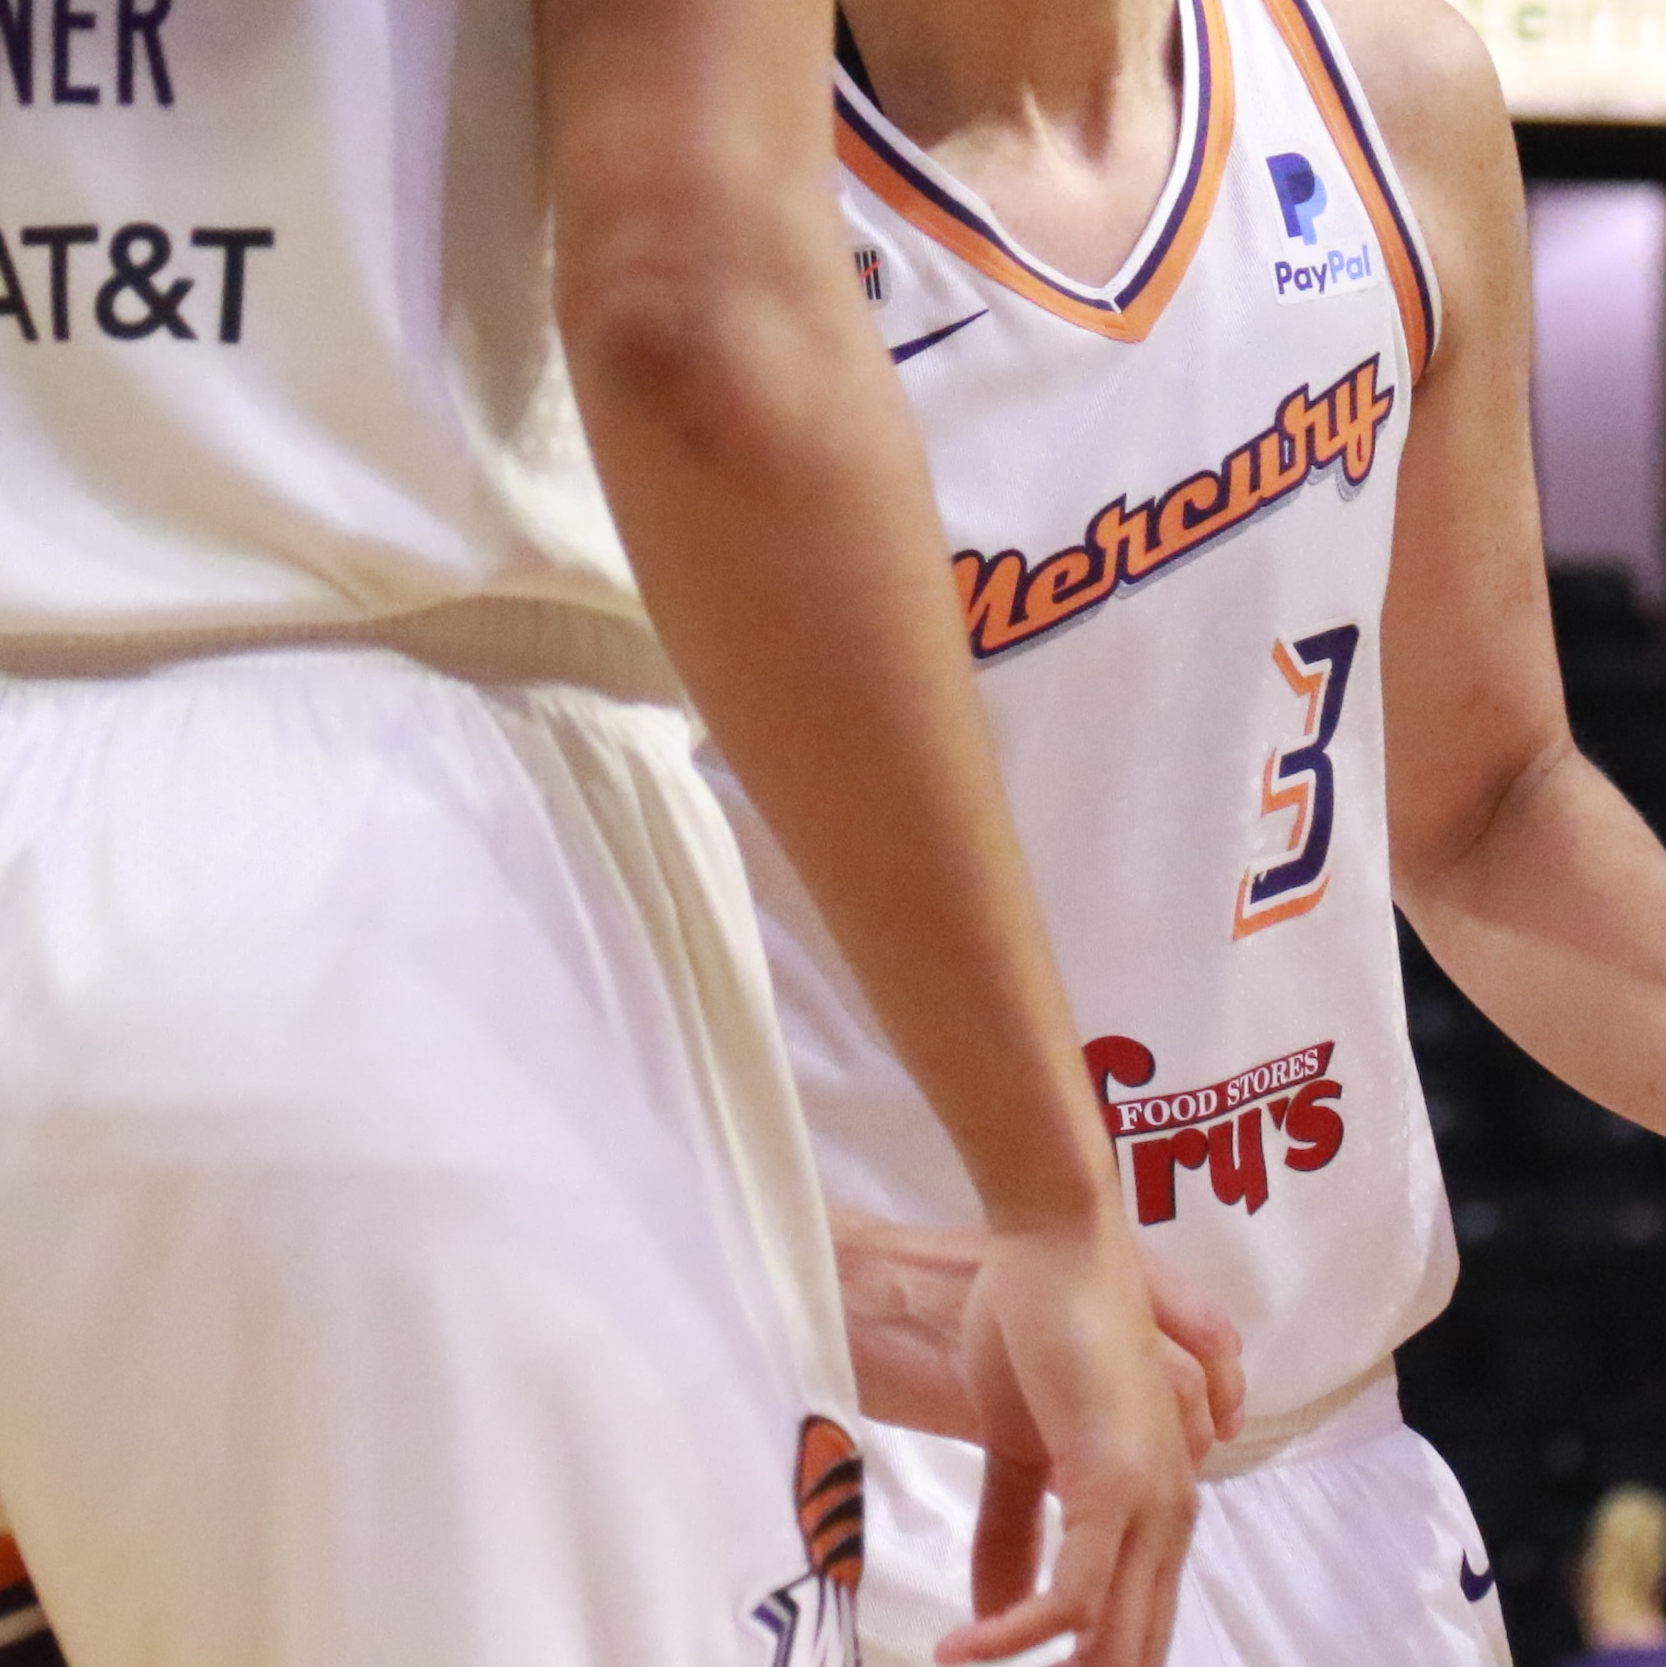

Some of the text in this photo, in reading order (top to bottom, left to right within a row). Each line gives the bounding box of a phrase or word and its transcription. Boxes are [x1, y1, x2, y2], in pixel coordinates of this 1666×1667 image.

[1275, 242, 1372, 295] PayPal
[952, 352, 1395, 660] Mercury
[1233, 624, 1360, 942] 3
[1117, 1048, 1319, 1131] FOOD STORES
